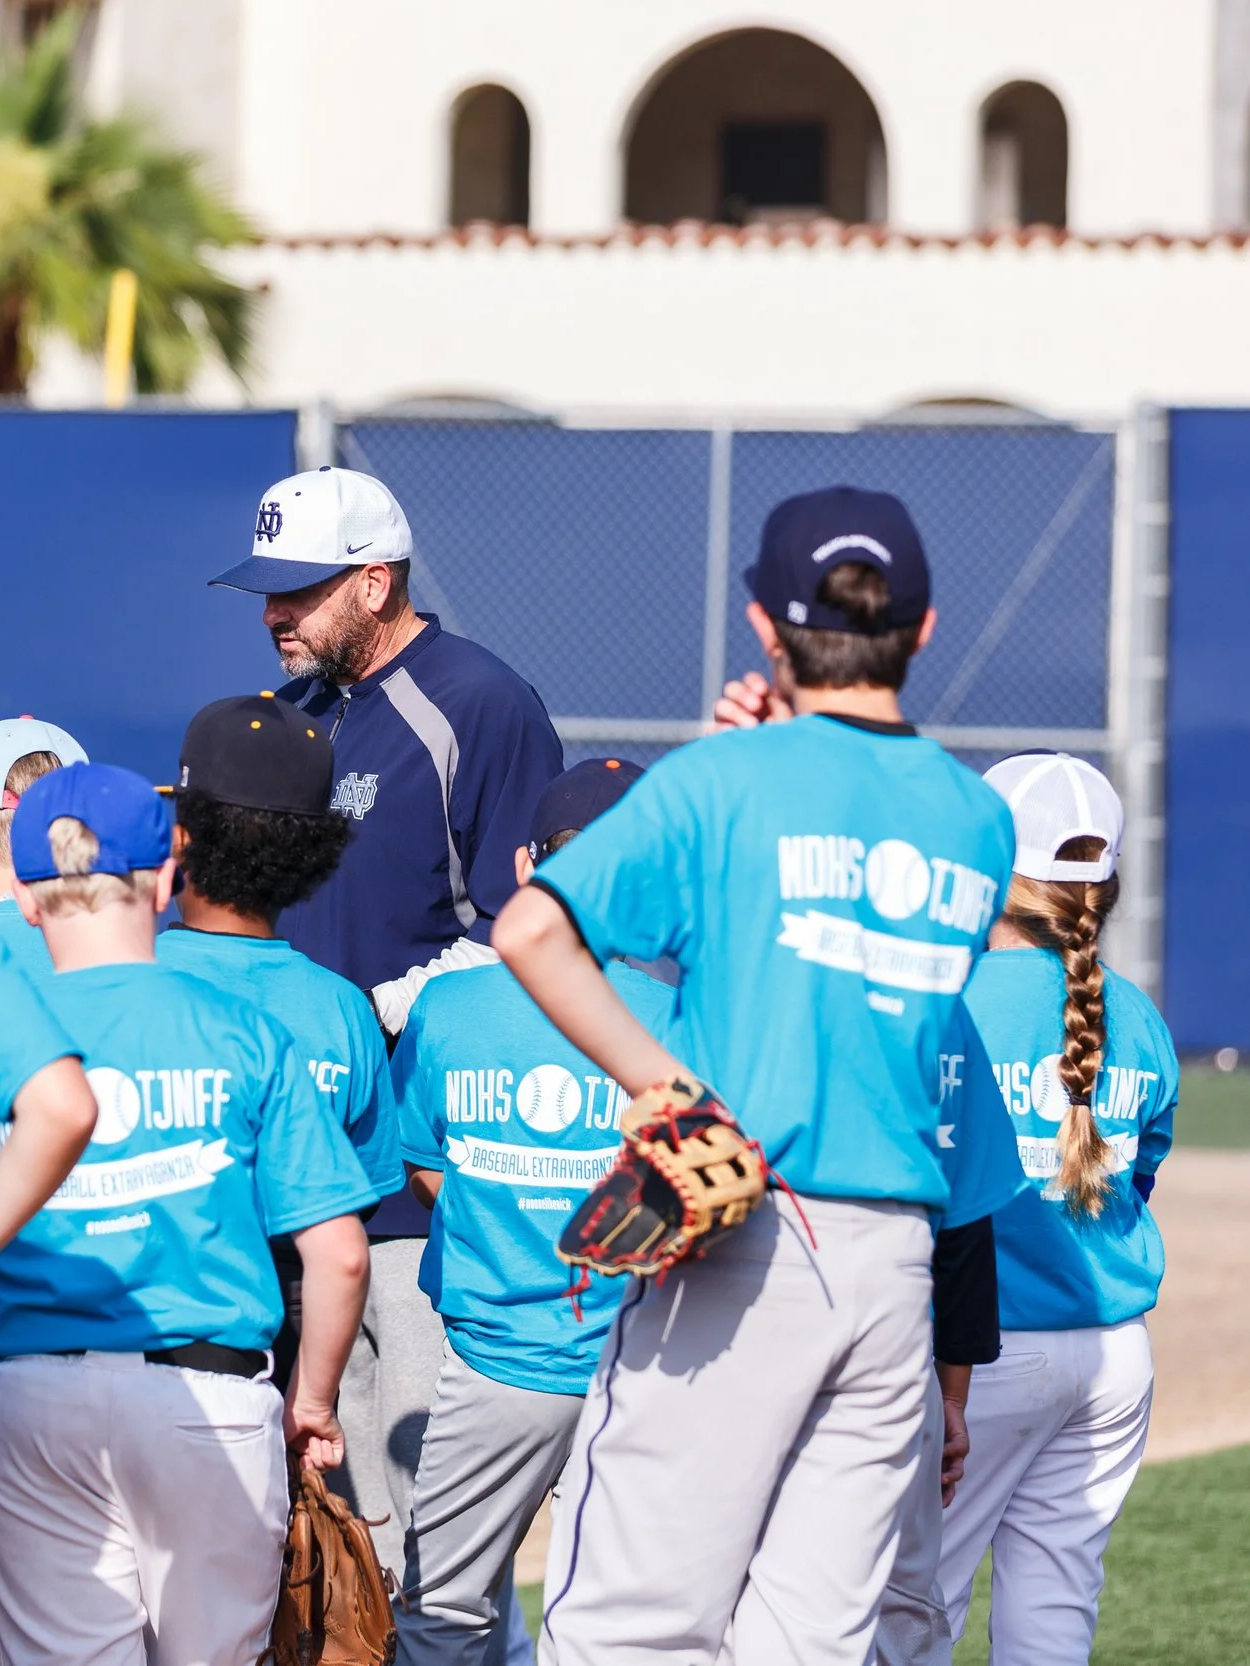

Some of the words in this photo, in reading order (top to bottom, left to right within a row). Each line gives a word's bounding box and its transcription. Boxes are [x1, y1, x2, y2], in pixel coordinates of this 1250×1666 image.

[777, 834, 866, 901] NDHS
[134, 1068, 232, 1130] TJNFF
[445, 1068, 514, 1123] NDHS
[584, 1075, 634, 1131] TJN
[471, 1146, 529, 1177] BASEBALL
[532, 1156, 617, 1181] EXTRAVAGANZ
